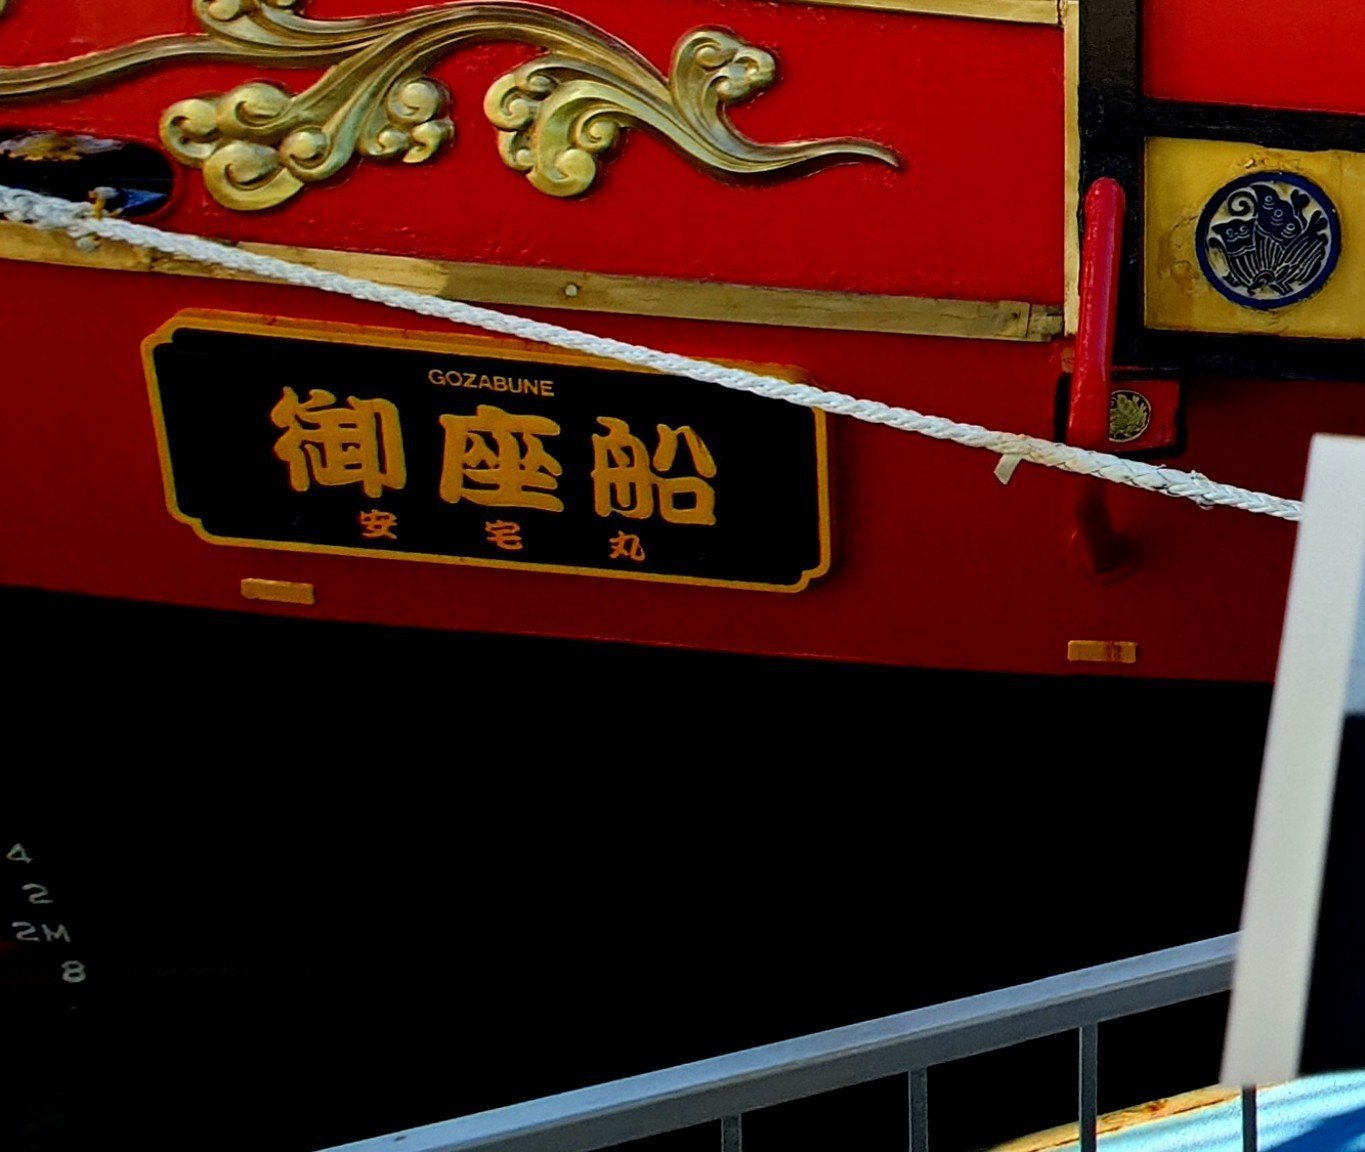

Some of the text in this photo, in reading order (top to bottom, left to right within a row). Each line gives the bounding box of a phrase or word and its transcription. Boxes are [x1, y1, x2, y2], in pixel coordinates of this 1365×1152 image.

[427, 368, 555, 398] GOZABUNE
[270, 385, 718, 526] 御座船
[21, 883, 54, 904] 2
[12, 921, 71, 943] 2M
[61, 960, 87, 984] 8
